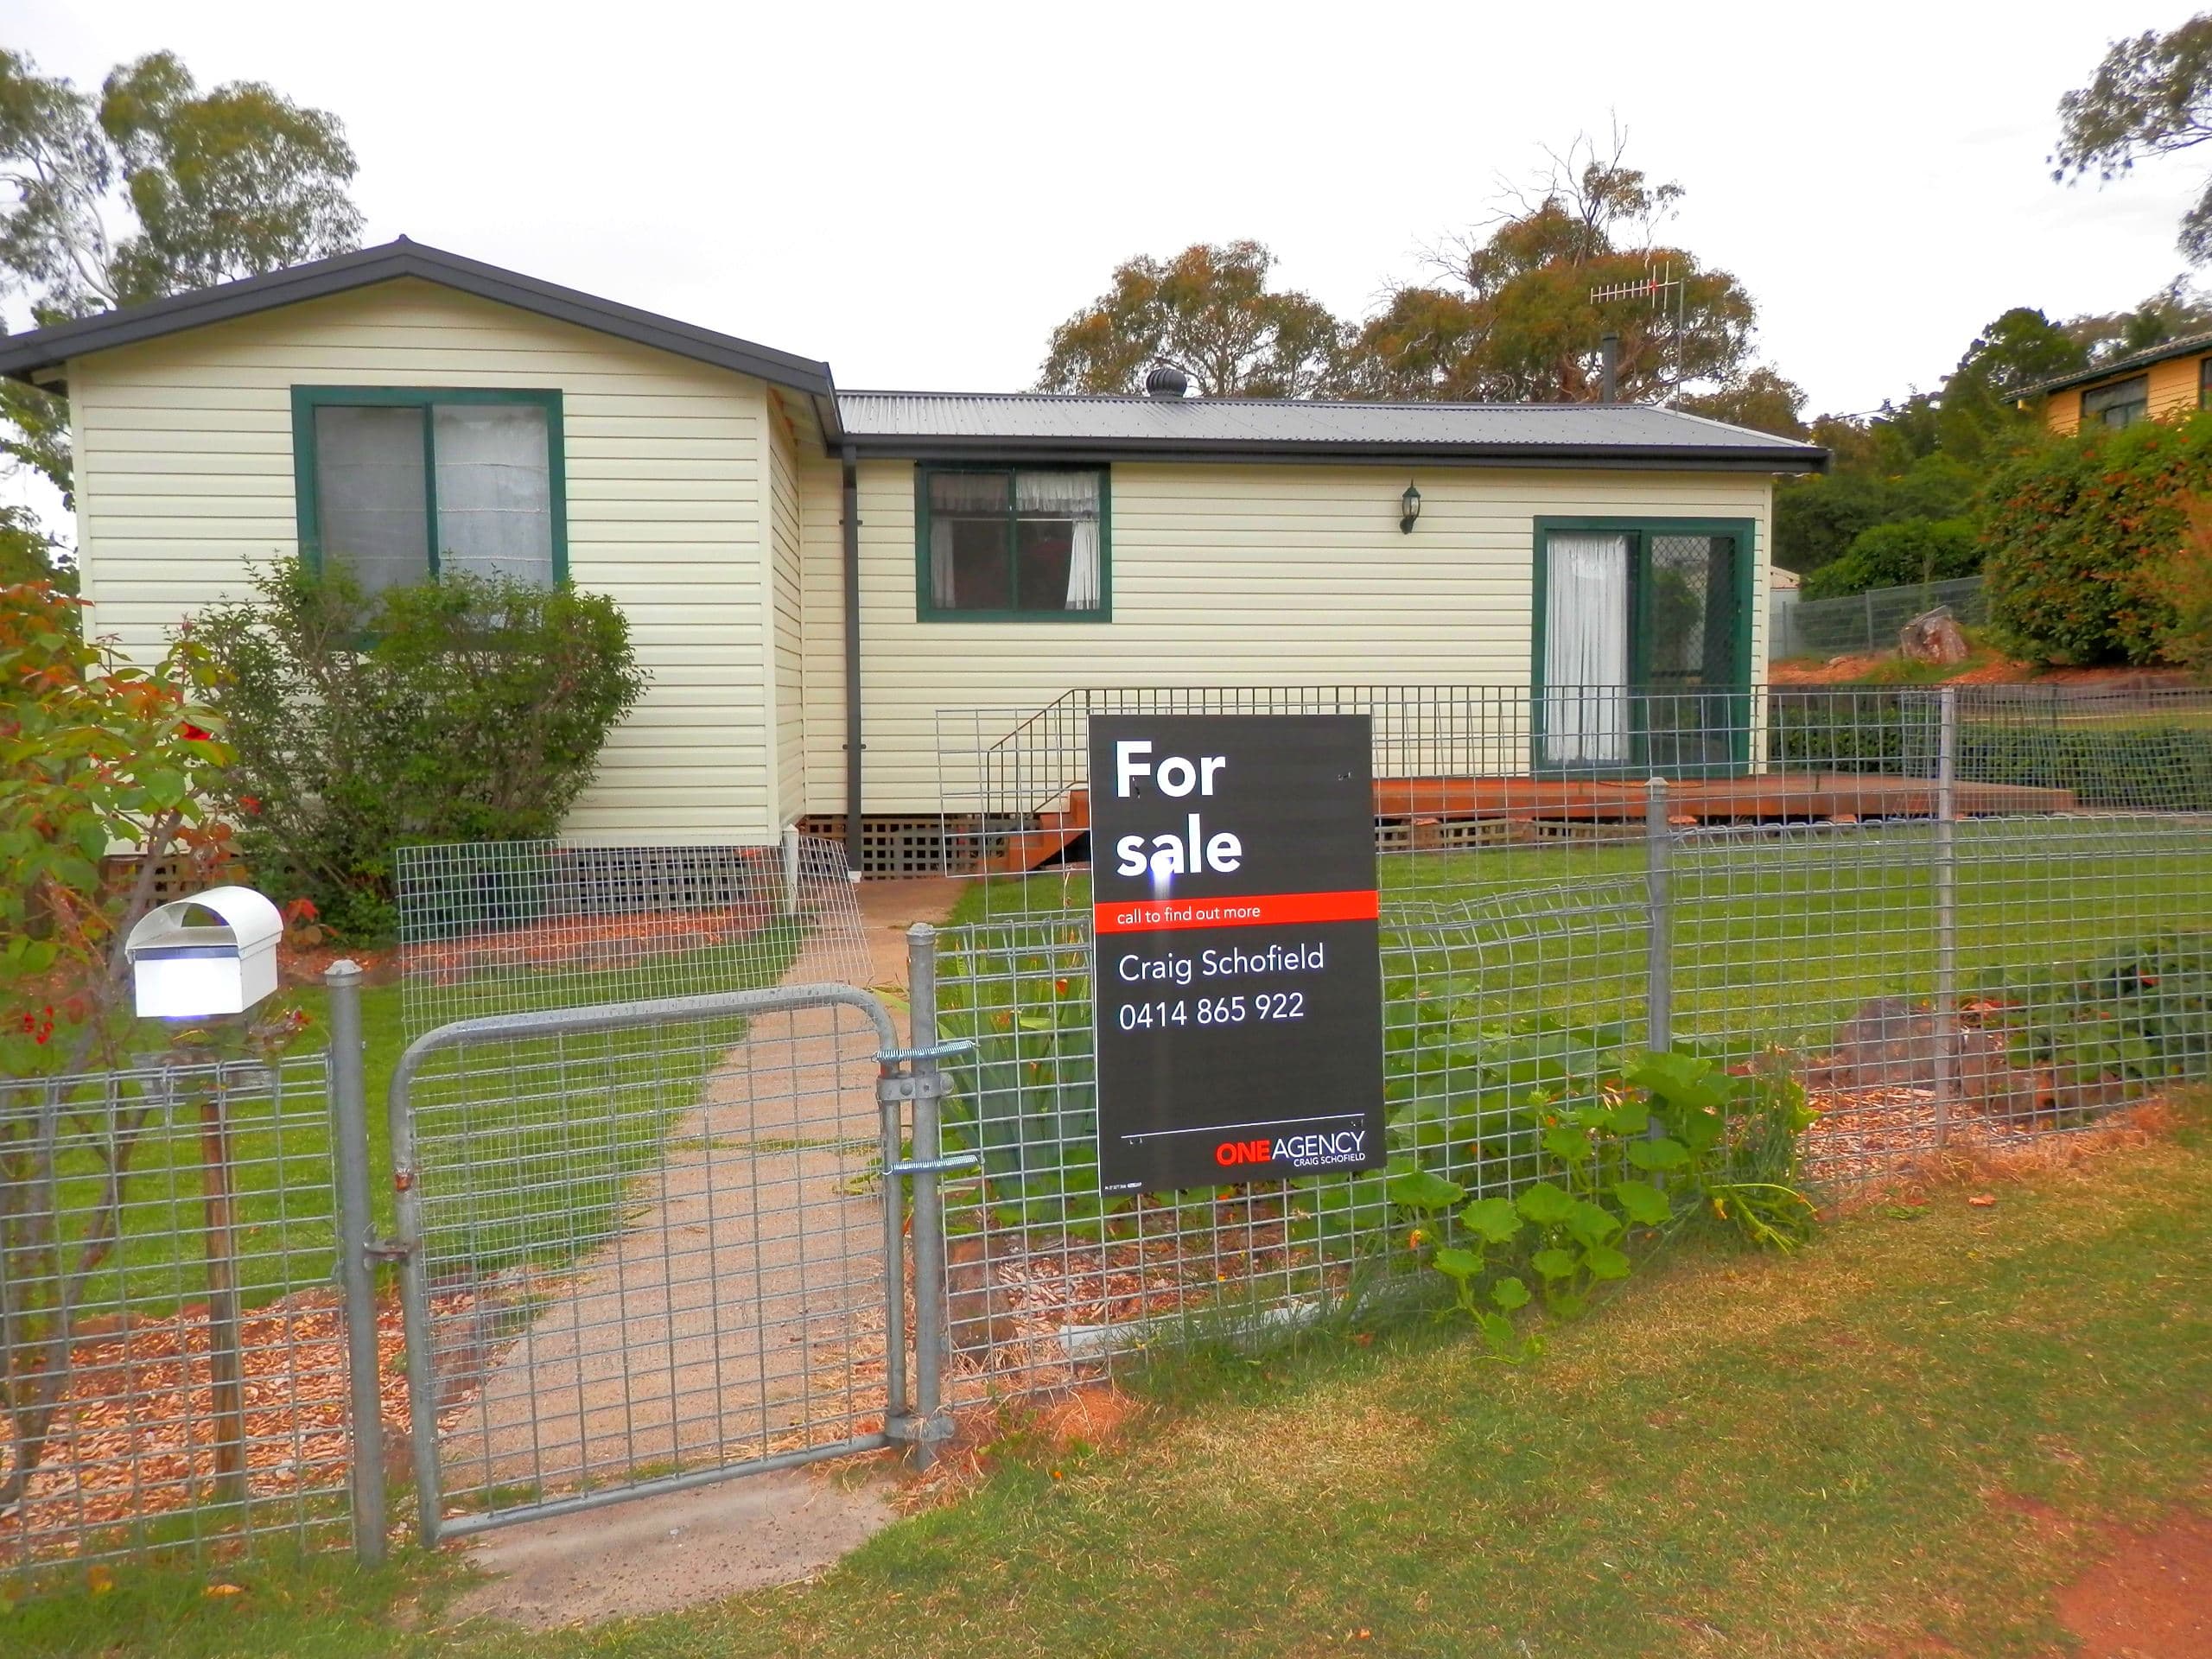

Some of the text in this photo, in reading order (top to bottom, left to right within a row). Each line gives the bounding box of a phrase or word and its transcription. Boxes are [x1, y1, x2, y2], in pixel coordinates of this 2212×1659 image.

[1116, 741, 1225, 798] For
[1116, 814, 1242, 877] sale
[1117, 906, 1261, 925] call to find out more
[1119, 943, 1324, 985] Craig Schofield
[1119, 992, 1305, 1030] 0414 865 922
[1294, 1152, 1365, 1167] CRAIG SCHOFIELD
